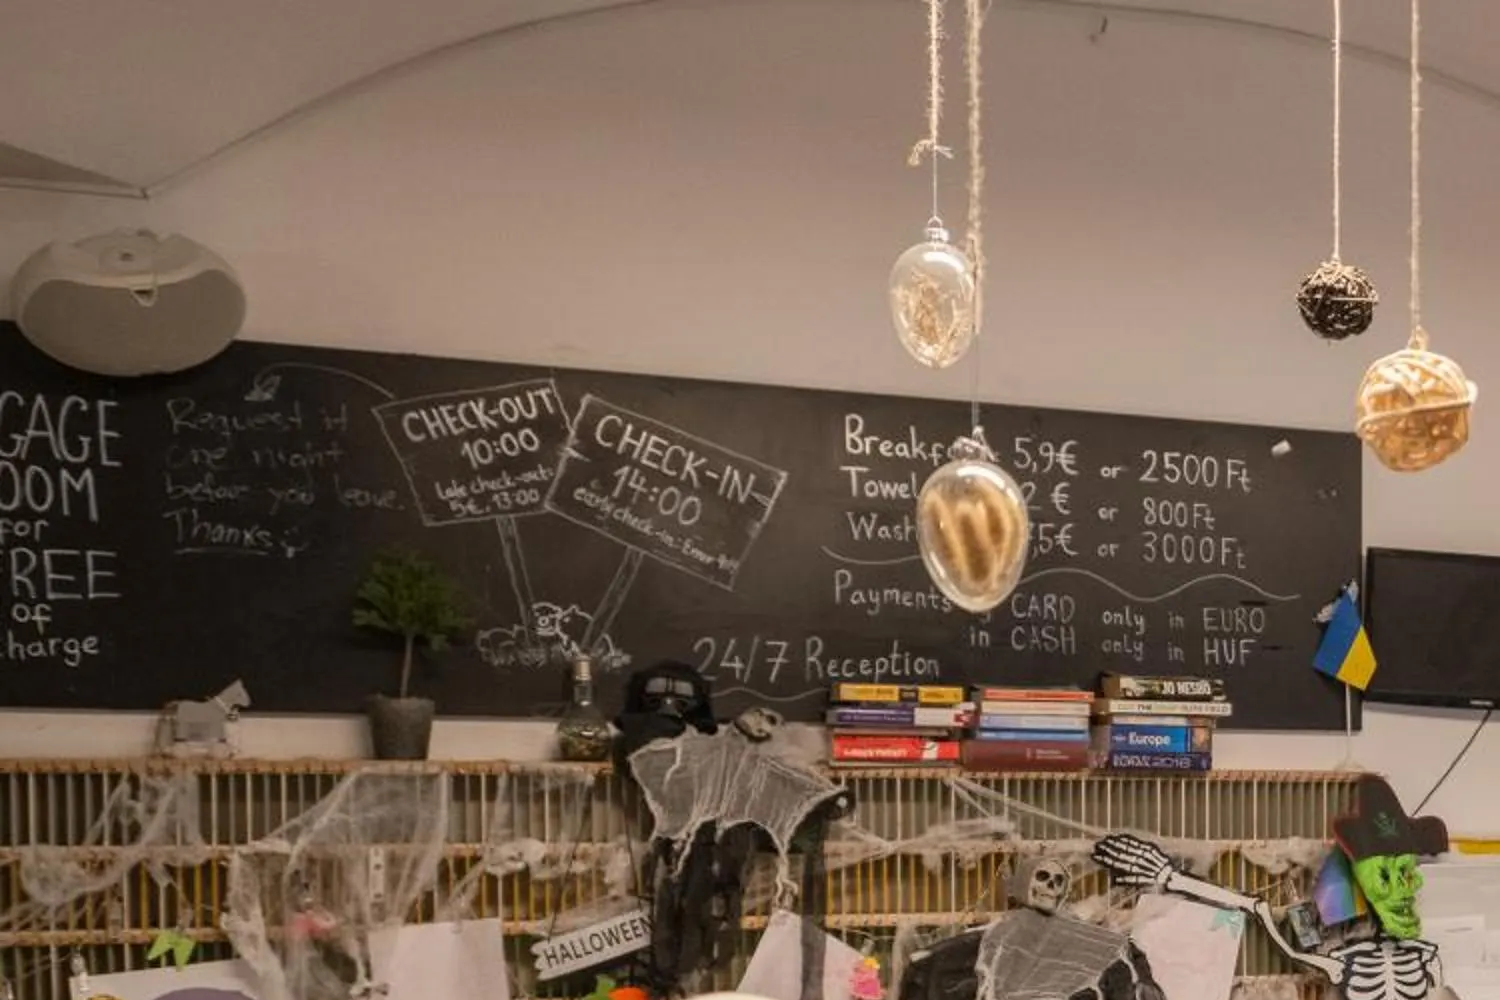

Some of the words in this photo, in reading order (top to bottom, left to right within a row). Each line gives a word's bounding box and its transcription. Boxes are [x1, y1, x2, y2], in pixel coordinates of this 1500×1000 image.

[0, 391, 123, 466] GAGE
[402, 387, 555, 443] CHECK-OUT
[461, 428, 540, 470] 10:00
[595, 414, 757, 505] CHECK-IN
[845, 413, 948, 468] Breakf
[1013, 437, 1080, 475] 5,9€
[1100, 464, 1123, 479] or
[1139, 449, 1219, 488] 2500
[1226, 458, 1251, 493] Ft
[612, 464, 703, 525] 14:00
[1097, 506, 1120, 521] or
[1142, 496, 1188, 528] 800
[1193, 503, 1217, 531] Ft
[1029, 522, 1080, 559] ,5€
[1097, 543, 1120, 558] or
[1142, 531, 1216, 564] 3000
[1220, 537, 1247, 570] Ft
[0, 547, 123, 600] REE
[11, 603, 52, 636] of
[834, 569, 955, 617] Payments
[1010, 592, 1077, 625] CARD
[1102, 605, 1146, 636] only
[1167, 611, 1186, 630] in
[1202, 606, 1266, 634] EURO
[0, 629, 100, 668] harge
[693, 636, 791, 684] 24/7
[805, 636, 942, 685] Reception
[969, 626, 991, 648] in
[1010, 624, 1078, 656] CASH
[1167, 642, 1186, 664] in
[1203, 637, 1258, 667] HUF
[1128, 731, 1171, 748] Europe
[543, 916, 652, 970] HALLOWEEN
